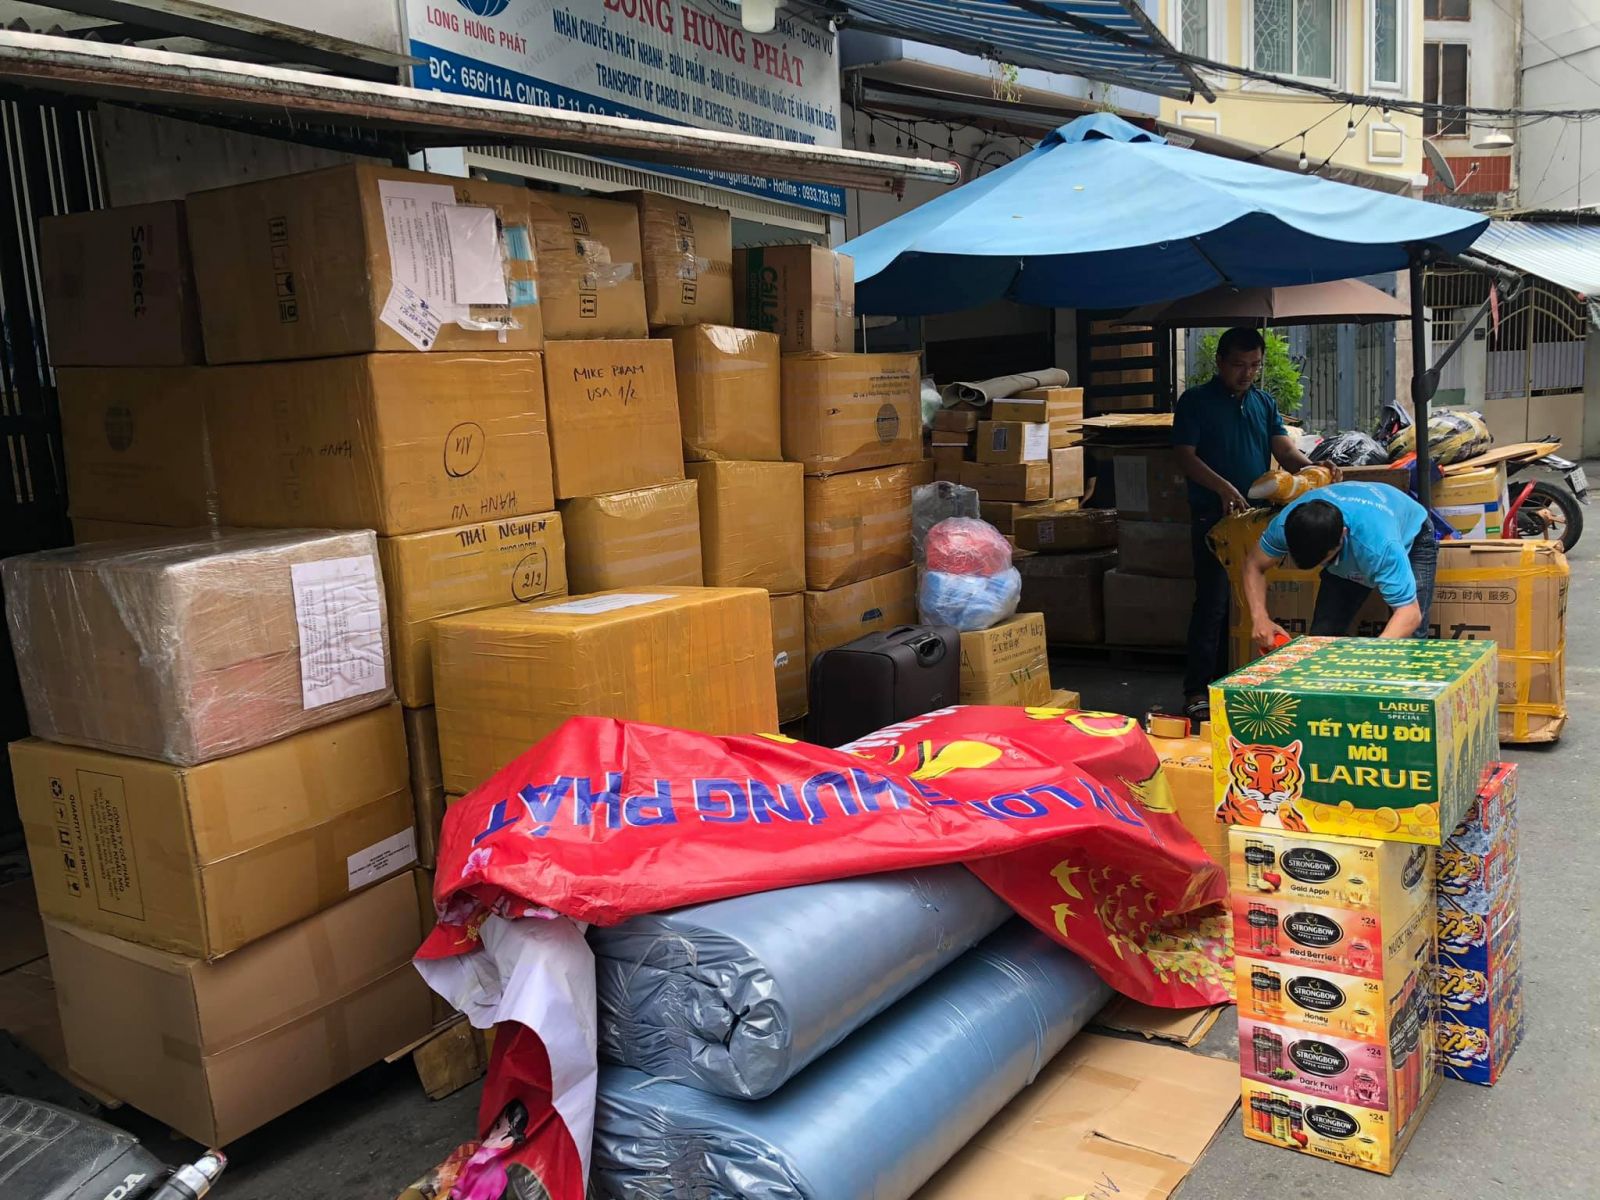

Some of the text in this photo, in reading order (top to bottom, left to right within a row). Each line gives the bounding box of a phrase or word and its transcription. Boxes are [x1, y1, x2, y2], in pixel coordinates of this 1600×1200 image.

[427, 5, 527, 55] LONG HƯNG PHÁT
[552, 7, 578, 42] NHẬN
[580, 16, 614, 53] CHUYỂN
[615, 31, 636, 60] PHÁT
[637, 40, 664, 70] NHANH
[681, 5, 745, 64] HƯNG
[752, 43, 804, 87] PHÁT
[801, 28, 820, 50] DỊCH
[822, 40, 833, 58] VỤ
[429, 56, 457, 84] ĐC:
[461, 66, 513, 100] 656/11A
[596, 63, 642, 99] TRANSPORT
[644, 80, 654, 101] OF
[655, 83, 679, 110] CARGO
[680, 92, 690, 113] BY
[692, 95, 703, 118] AIR
[704, 100, 733, 128] EXPRESS
[738, 112, 750, 133] SEA
[751, 115, 774, 140] FREIGHT
[773, 177, 797, 197] Hotline
[131, 225, 147, 319] Select
[573, 366, 604, 382] MIKE
[587, 380, 638, 406] USA 1/2
[480, 491, 518, 514] HANH
[522, 570, 543, 588] 2/2
[1462, 590, 1483, 601] 时尚
[1488, 590, 1510, 601] 服务
[1378, 701, 1430, 713] LARUE
[1387, 713, 1422, 721] SPECIAL
[1307, 718, 1430, 742] TẾT YÊU ĐỜI
[1347, 743, 1388, 762] MỜI
[1309, 763, 1432, 792] LARUE
[1289, 859, 1331, 871] STRONGBOW
[1291, 884, 1307, 892] Gold
[1309, 887, 1330, 896] Apple
[1292, 923, 1334, 936] STRONGBOW
[1290, 948, 1306, 957] Red
[1307, 949, 1337, 962] Berries
[1294, 987, 1337, 1001] STRONGBOW
[1304, 1012, 1329, 1024] Honey
[1296, 1050, 1340, 1066] STRONGBOW
[1300, 1077, 1318, 1087] Dark
[1320, 1081, 1339, 1092] Fruit
[1311, 1115, 1353, 1129] STRONGBOW
